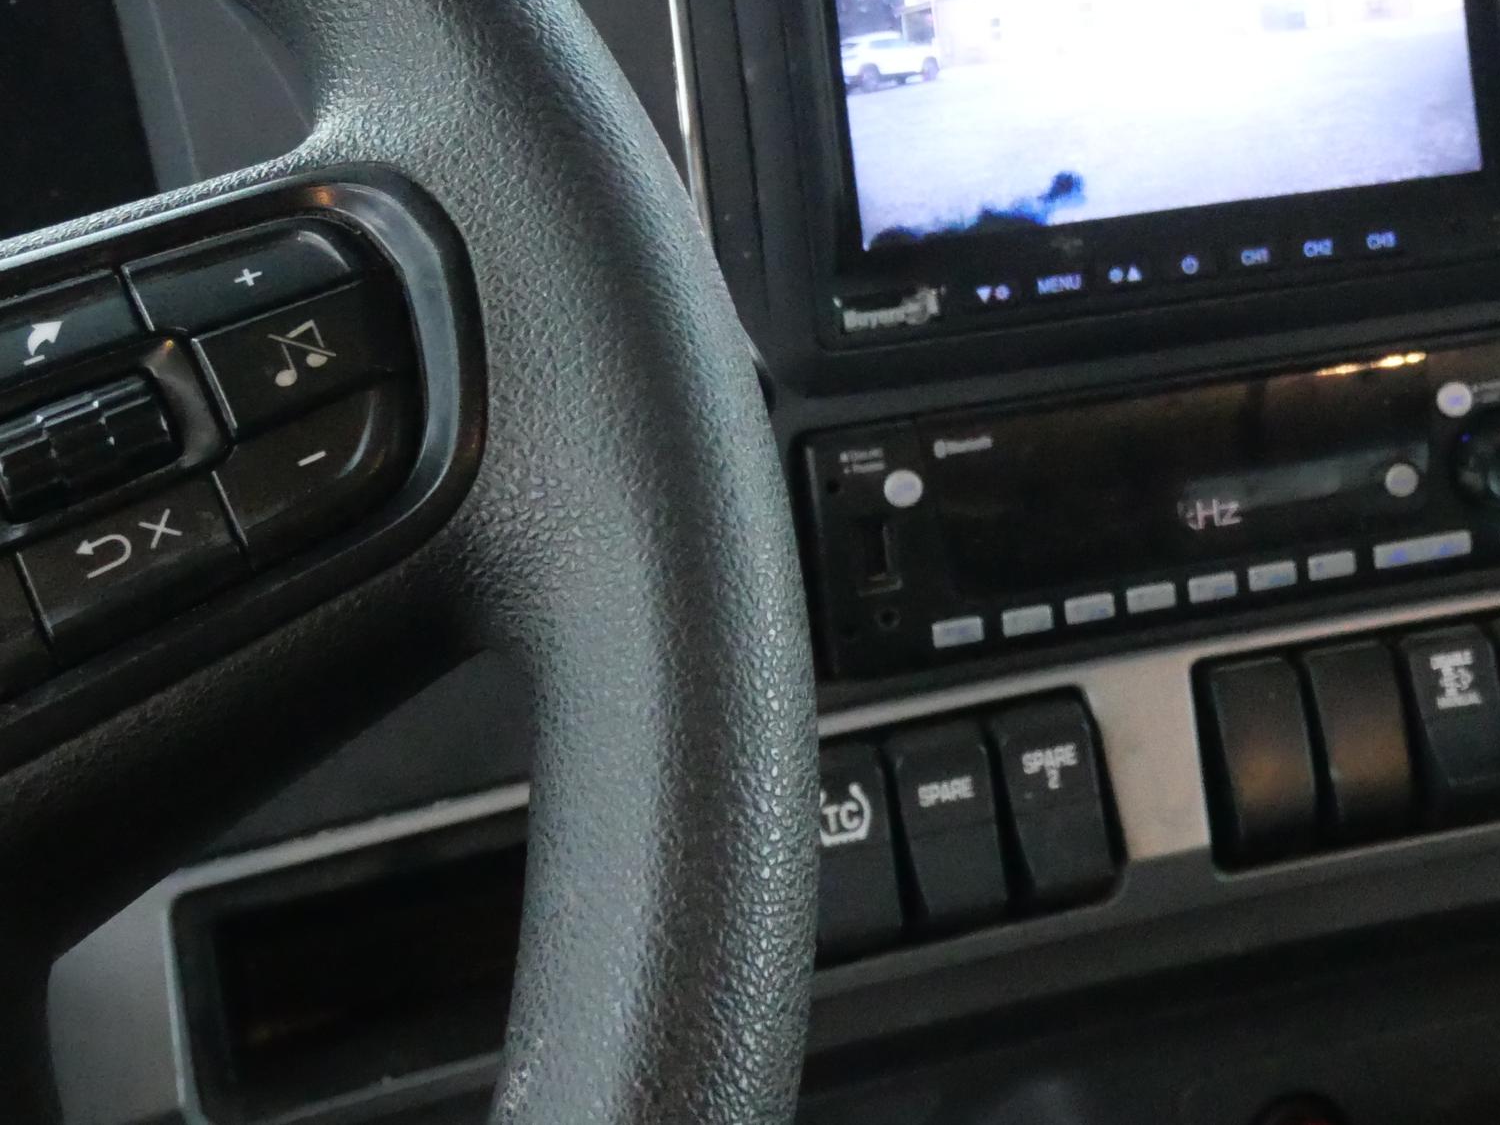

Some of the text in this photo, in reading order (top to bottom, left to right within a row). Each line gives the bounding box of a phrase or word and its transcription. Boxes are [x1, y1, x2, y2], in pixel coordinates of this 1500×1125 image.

[1036, 273, 1082, 296] MENU
[1021, 743, 1079, 775] SPARE
[917, 775, 975, 808] SPARE
